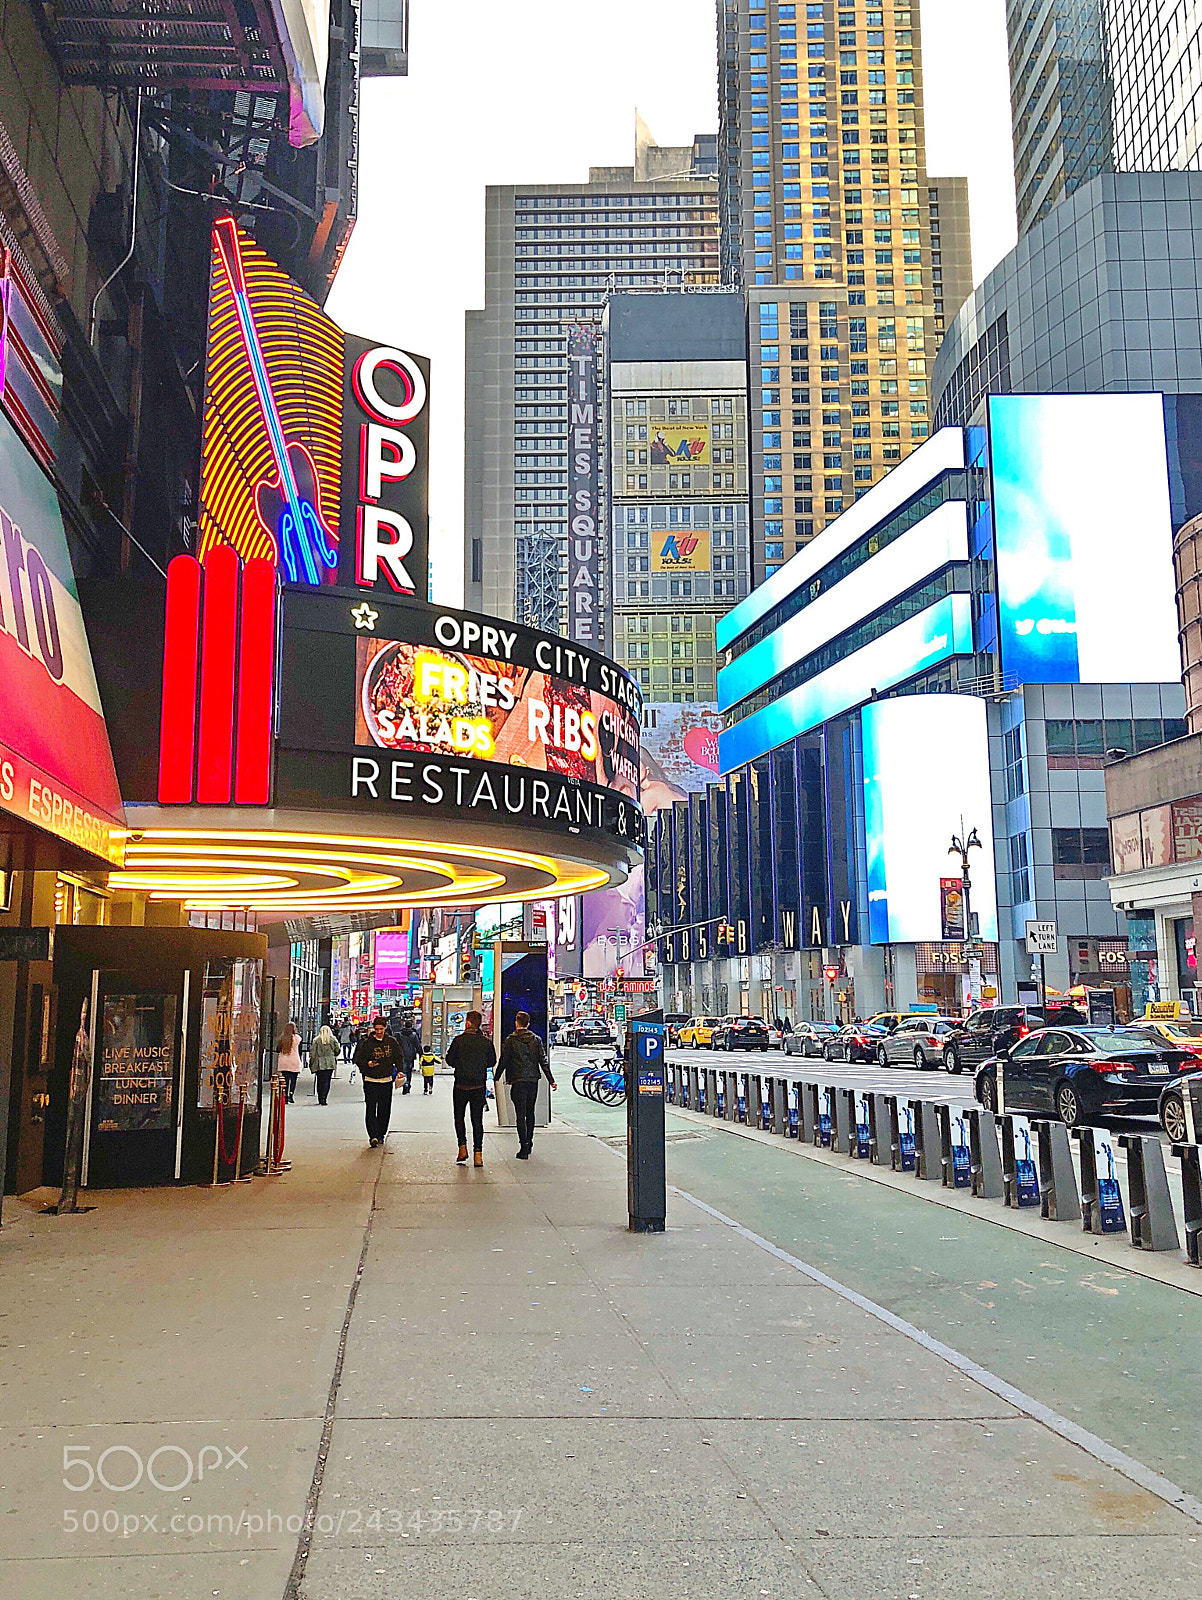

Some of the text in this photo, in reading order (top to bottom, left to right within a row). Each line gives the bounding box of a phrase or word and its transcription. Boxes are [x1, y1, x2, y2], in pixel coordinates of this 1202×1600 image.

[676, 437, 706, 458] KTU
[571, 355, 595, 640] TIMES SQUARE
[660, 533, 699, 558] KTU
[0, 508, 64, 681] ro
[434, 615, 640, 714] OPRY CITY STAGE
[421, 661, 517, 711] FRIES
[377, 709, 492, 752] SALADS
[527, 699, 597, 760] RIBS
[0, 757, 14, 801] S
[351, 757, 606, 828] RESTAURANT
[1037, 924, 1054, 932] LEFT
[1038, 933, 1055, 941] TURN
[666, 927, 707, 963] 585
[1038, 942, 1056, 950] LANE
[623, 981, 655, 993] AMINOS
[105, 1046, 170, 1060] LIVE MUSIC
[646, 1037, 658, 1057] P
[104, 1061, 170, 1074] BREAKFAST
[115, 1077, 157, 1089] LUNCH
[113, 1092, 158, 1105] DINNER
